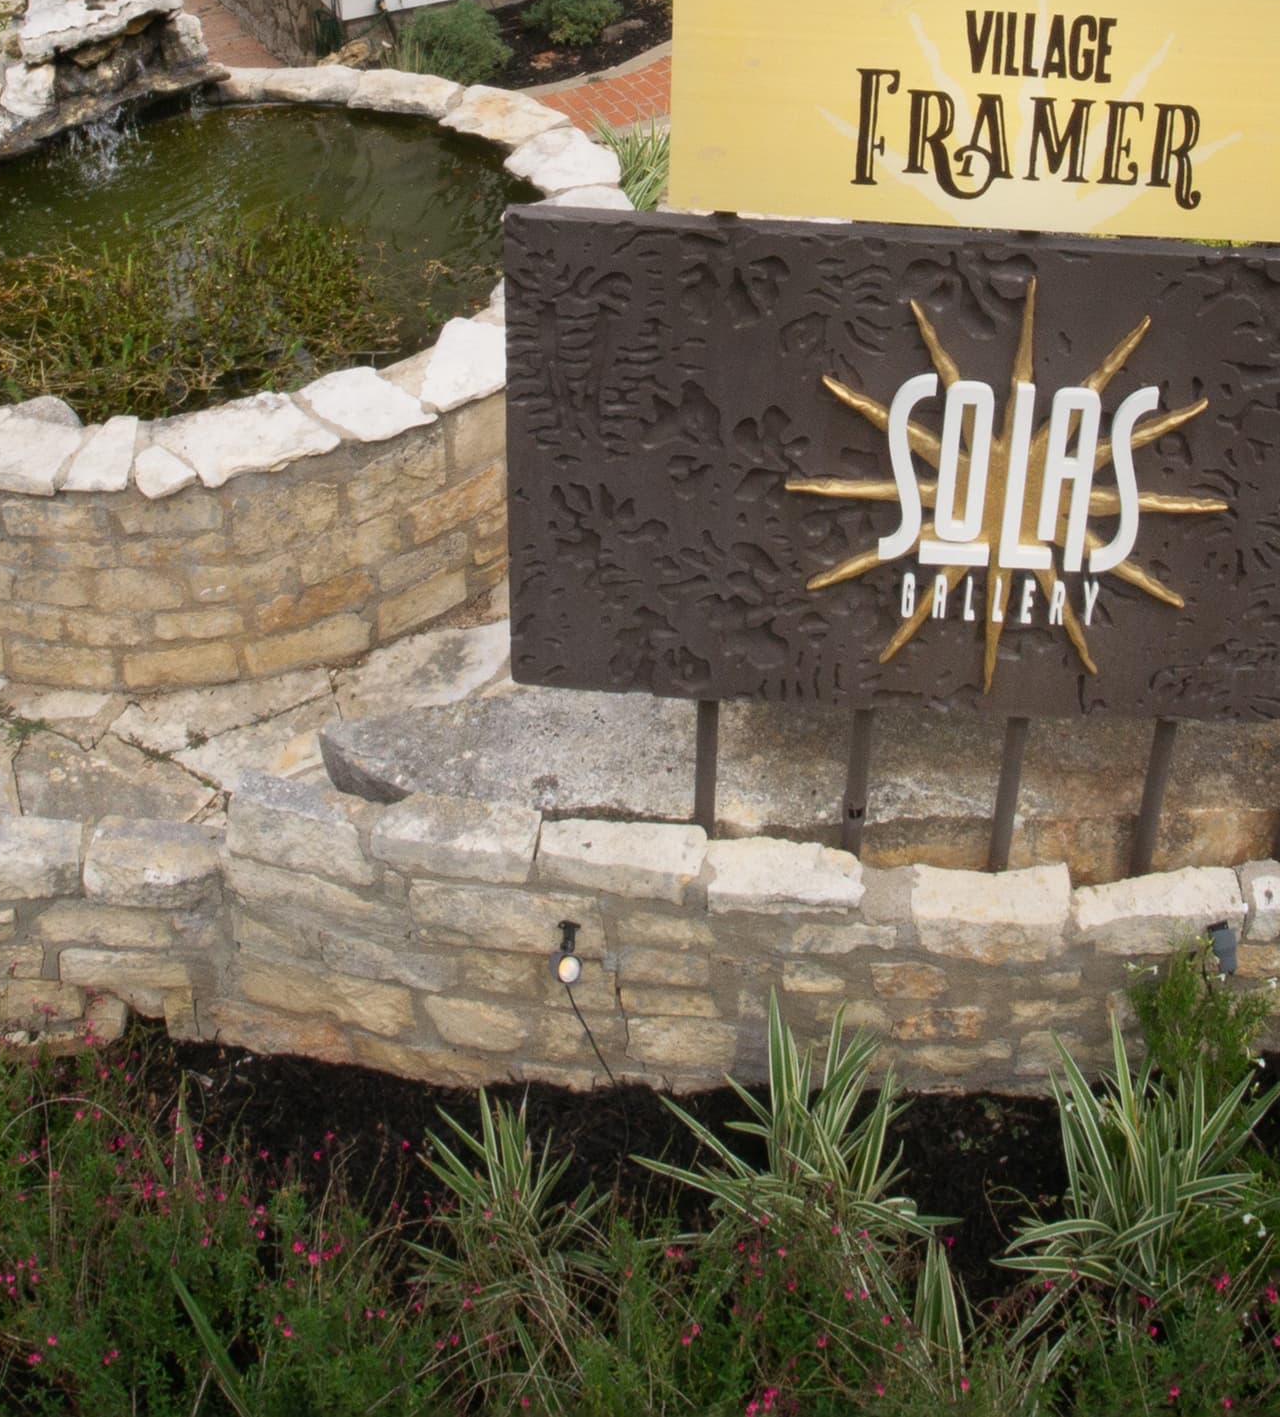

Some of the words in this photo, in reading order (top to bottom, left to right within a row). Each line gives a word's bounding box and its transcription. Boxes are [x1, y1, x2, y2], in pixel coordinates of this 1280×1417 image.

[966, 9, 1117, 84] VILLAGE
[851, 68, 1202, 210] FRAMER
[878, 373, 1160, 572] SOLAS
[900, 572, 1100, 626] GALLERY
